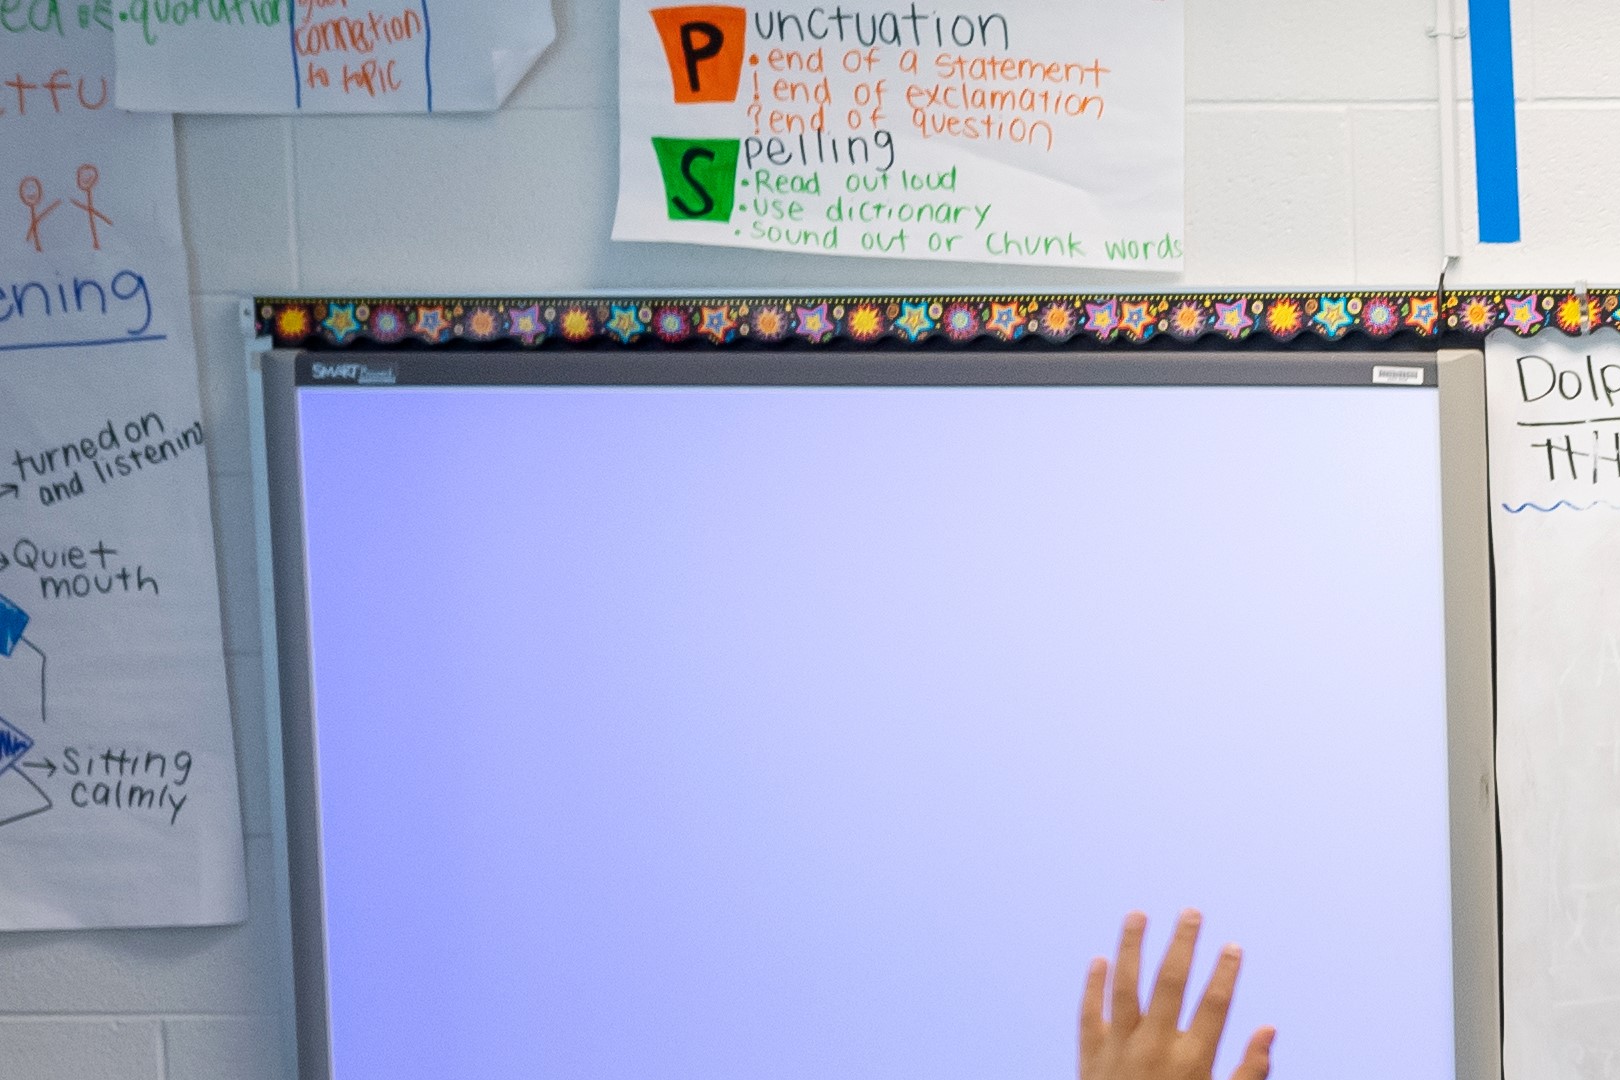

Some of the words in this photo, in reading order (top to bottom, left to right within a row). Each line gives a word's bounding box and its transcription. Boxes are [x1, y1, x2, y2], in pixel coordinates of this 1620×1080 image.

[767, 48, 824, 73] end
[842, 49, 880, 74] of
[899, 49, 918, 75] a
[772, 77, 832, 105] end
[854, 78, 887, 106] of
[905, 83, 1105, 120] exclamation
[768, 104, 825, 134] end
[847, 107, 884, 130] of
[911, 107, 1053, 152] question
[754, 170, 821, 195] Read
[845, 170, 890, 193] out
[901, 165, 958, 193] loud
[825, 196, 992, 230] dictionary
[860, 229, 906, 253] out
[927, 232, 964, 253] or
[1105, 238, 1185, 261] words
[13, 419, 120, 482] turned
[124, 412, 165, 443] on
[39, 471, 85, 507] and
[13, 537, 119, 571] Quiet
[40, 565, 159, 600] mouth
[71, 779, 188, 826] calmly
